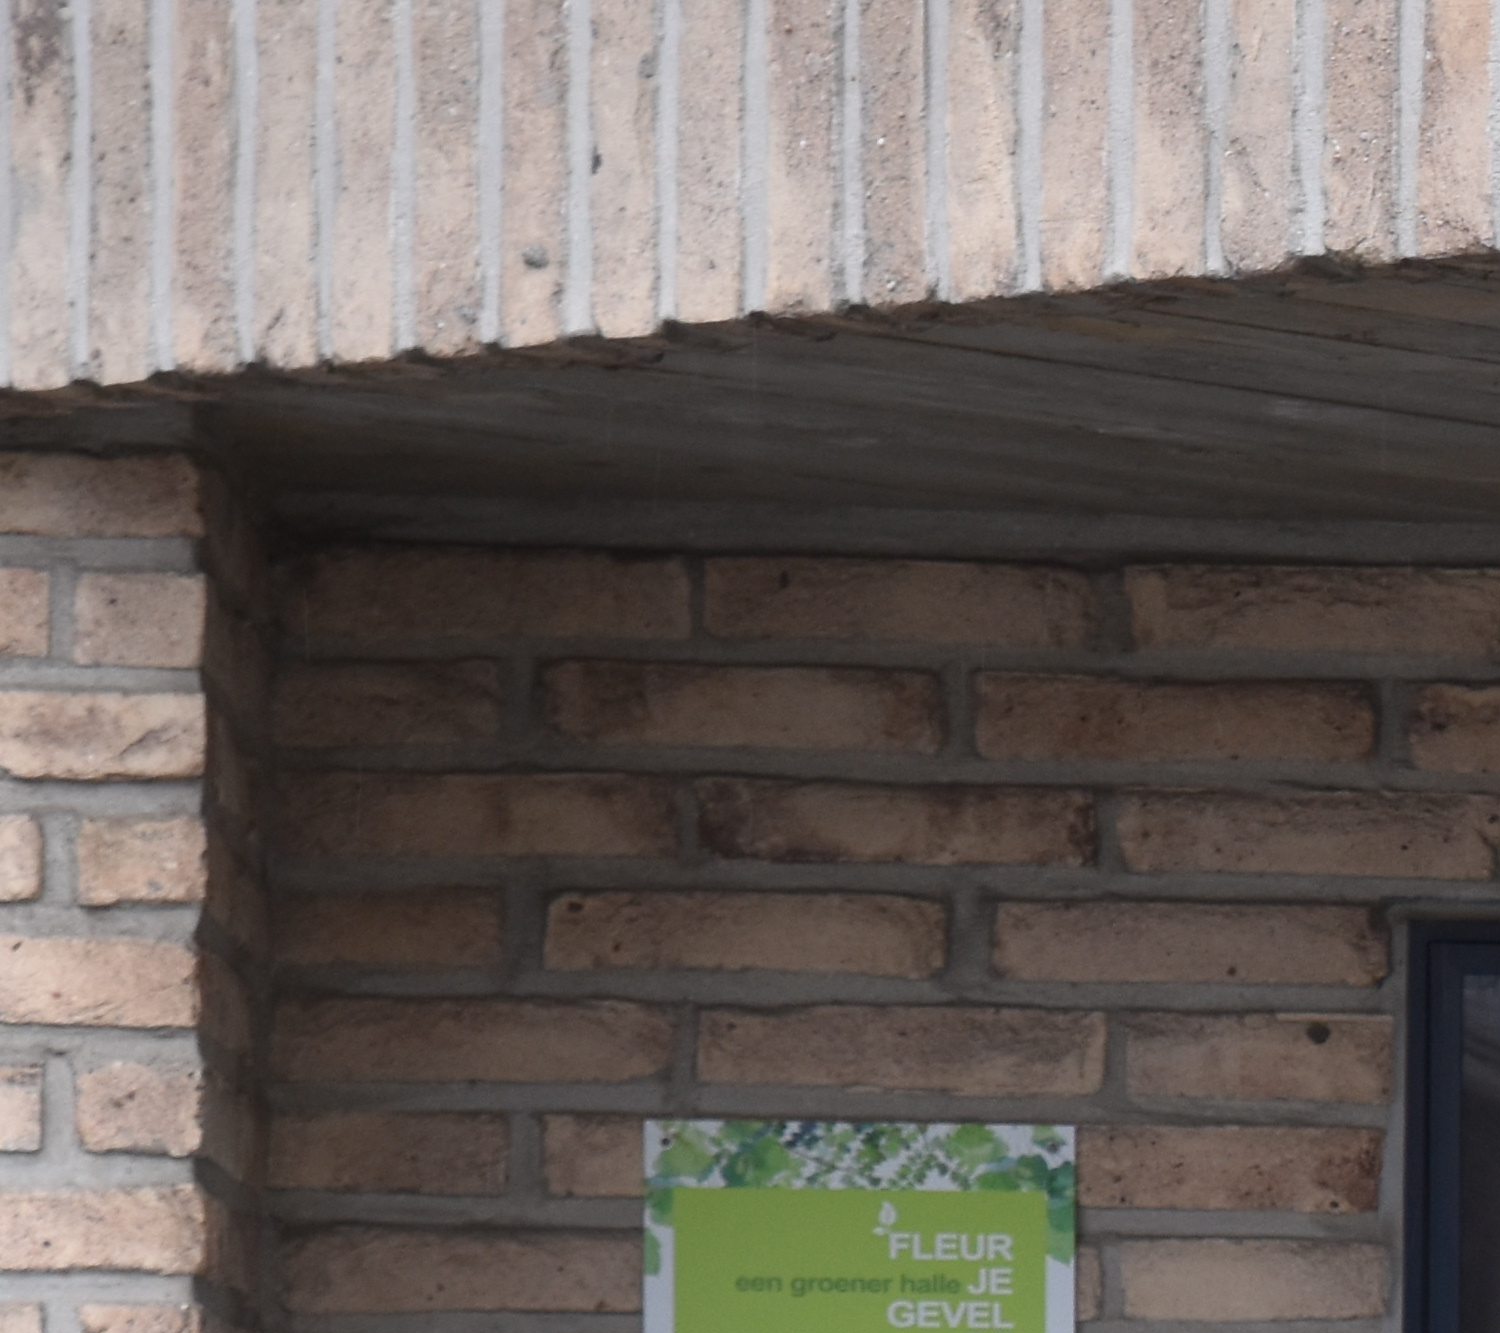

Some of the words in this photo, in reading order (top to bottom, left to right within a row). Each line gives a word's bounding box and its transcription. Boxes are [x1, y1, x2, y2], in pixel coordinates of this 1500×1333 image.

[888, 1232, 1013, 1261] FLEUR
[735, 1275, 782, 1294] een
[790, 1275, 892, 1298] groener
[900, 1273, 961, 1295] halle
[966, 1267, 1013, 1295] JE
[886, 1300, 1015, 1329] GEVEL
